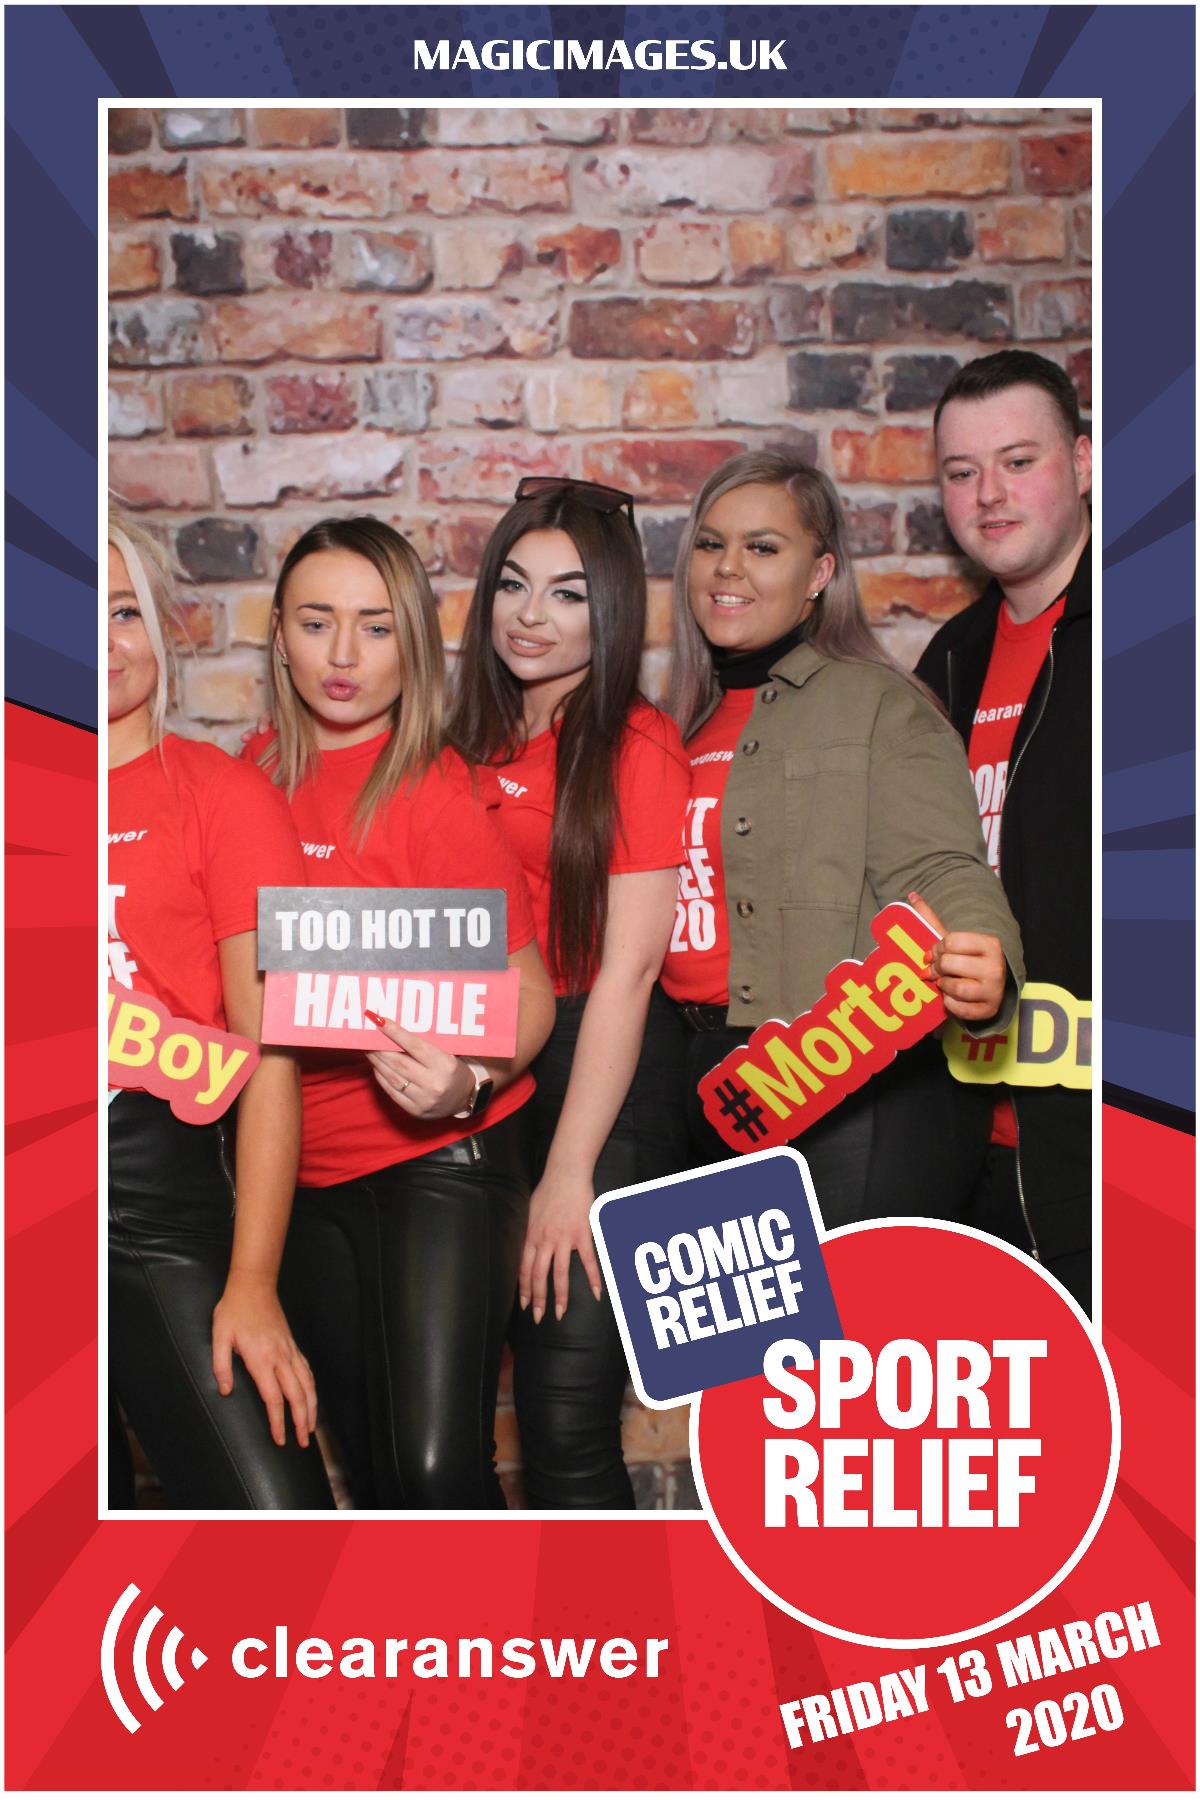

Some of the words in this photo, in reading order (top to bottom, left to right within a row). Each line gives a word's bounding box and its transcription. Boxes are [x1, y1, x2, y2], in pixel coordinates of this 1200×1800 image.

[972, 703, 1025, 725] learan
[300, 841, 336, 859] wer
[275, 909, 351, 951] TOO
[361, 908, 436, 950] HOT
[443, 907, 491, 948] TO
[293, 972, 488, 1037] HANDLE
[713, 923, 939, 1143] #Mortal
